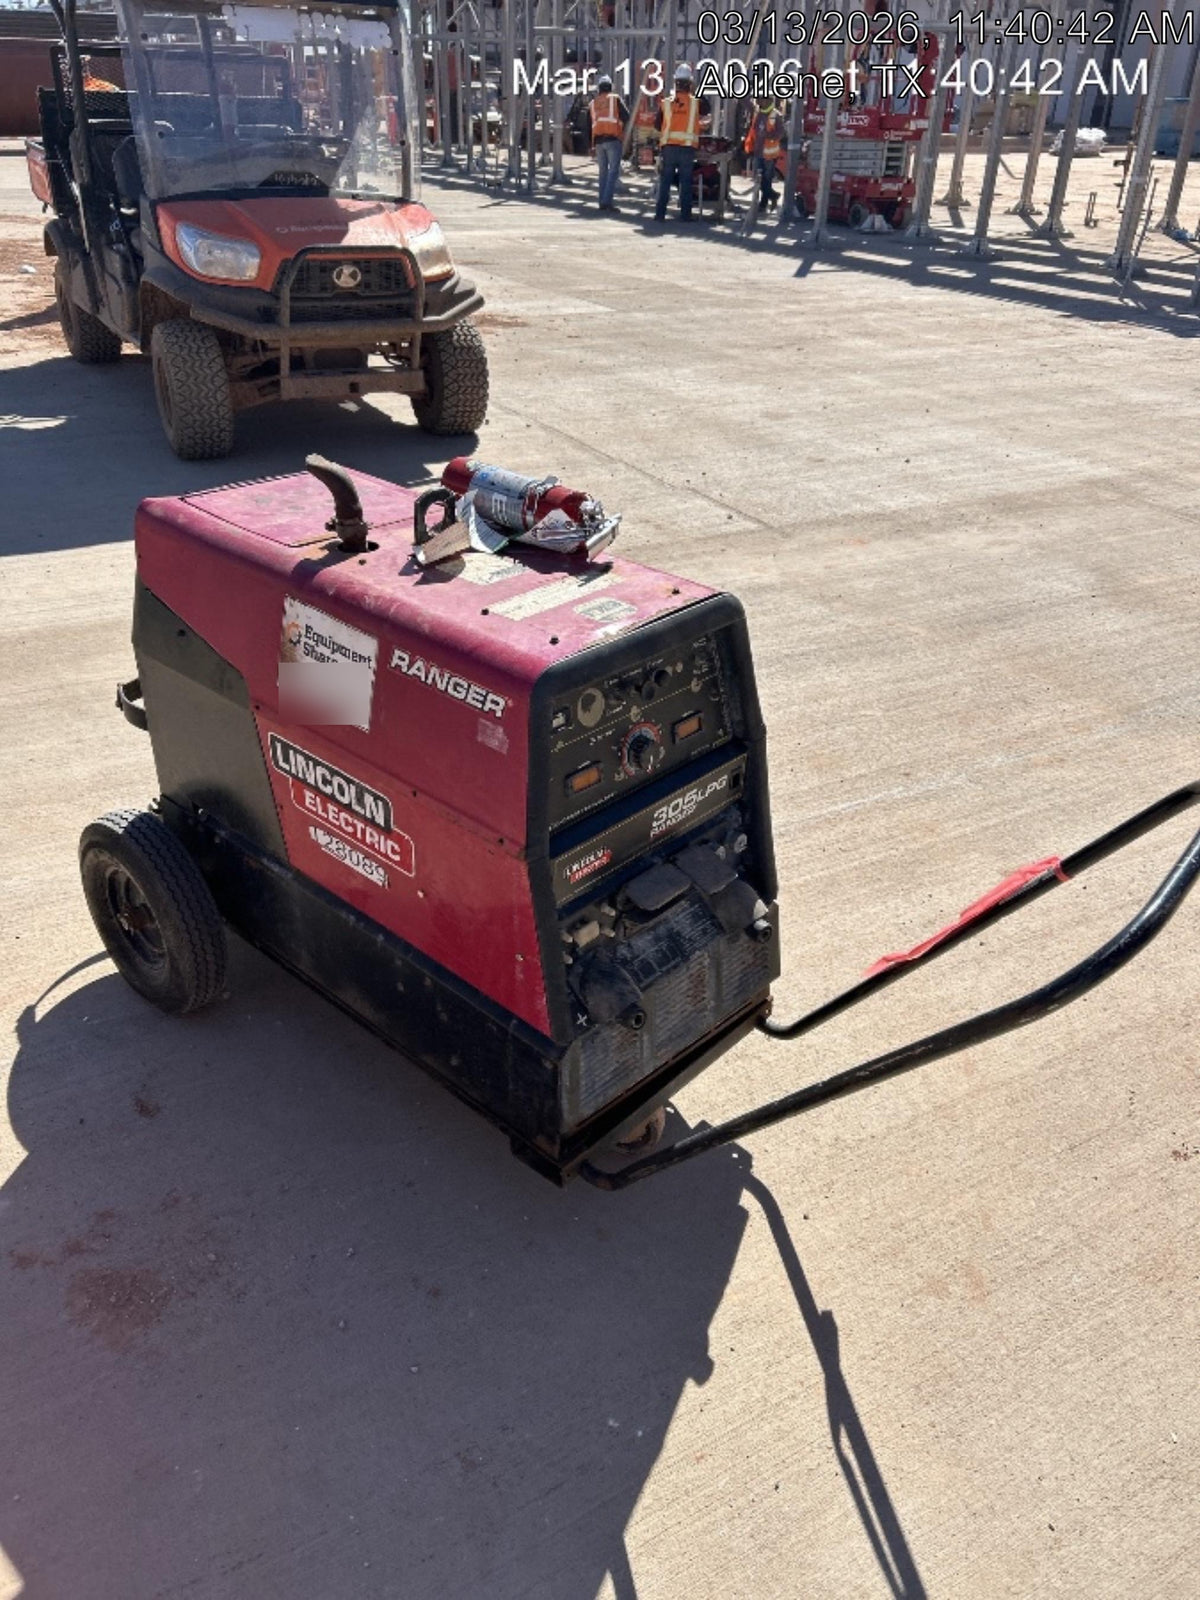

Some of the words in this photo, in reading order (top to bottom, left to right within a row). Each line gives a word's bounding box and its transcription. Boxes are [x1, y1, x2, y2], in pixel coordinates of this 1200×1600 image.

[303, 623, 373, 669] Equipment
[389, 648, 506, 718] RANGER
[274, 741, 386, 828] LINCOLN
[303, 788, 402, 861] ELECTRIC
